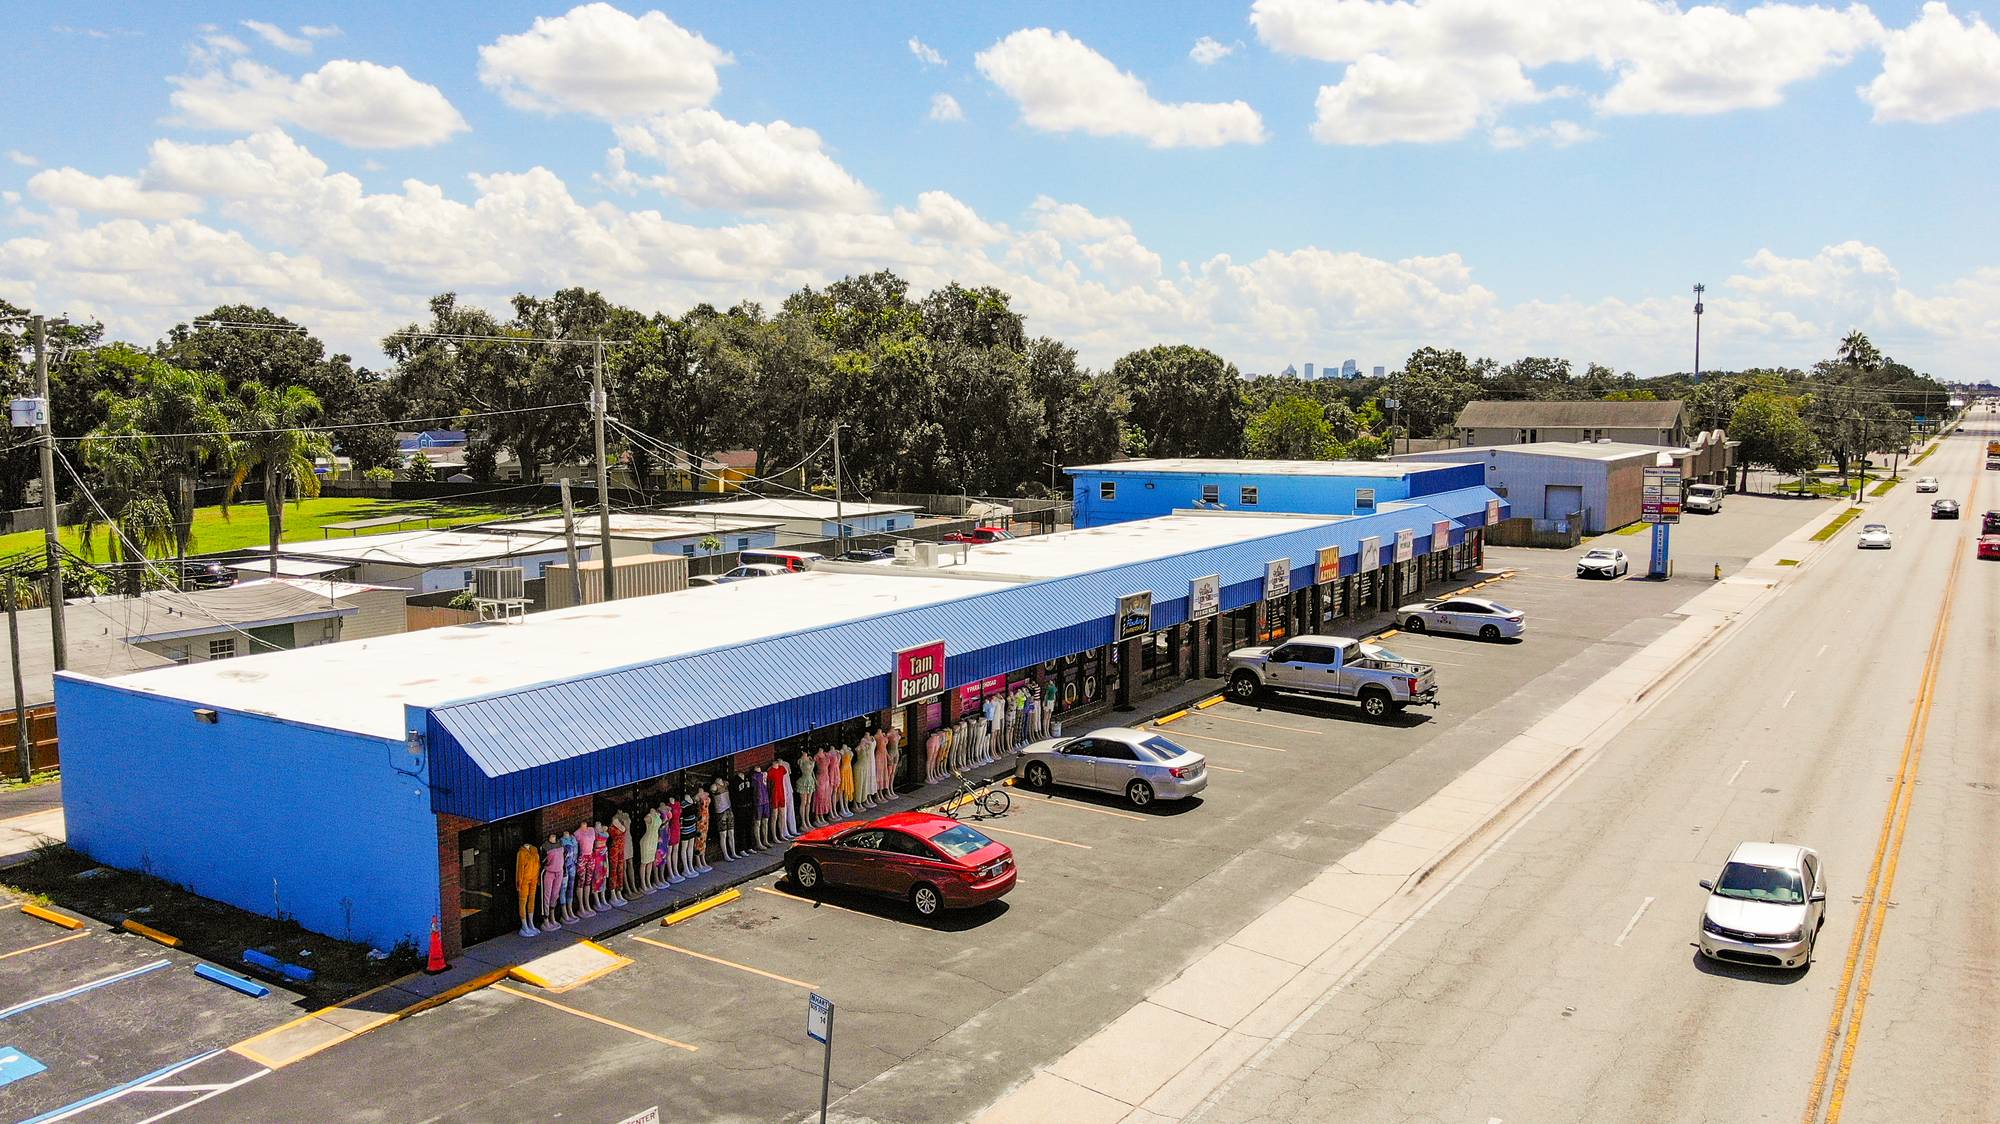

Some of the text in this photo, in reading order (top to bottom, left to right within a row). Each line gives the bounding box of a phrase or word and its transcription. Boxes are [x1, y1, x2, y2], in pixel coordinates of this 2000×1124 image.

[1320, 568, 1337, 580] AZTECA
[910, 656, 932, 675] Tam
[902, 673, 939, 698] Barato
